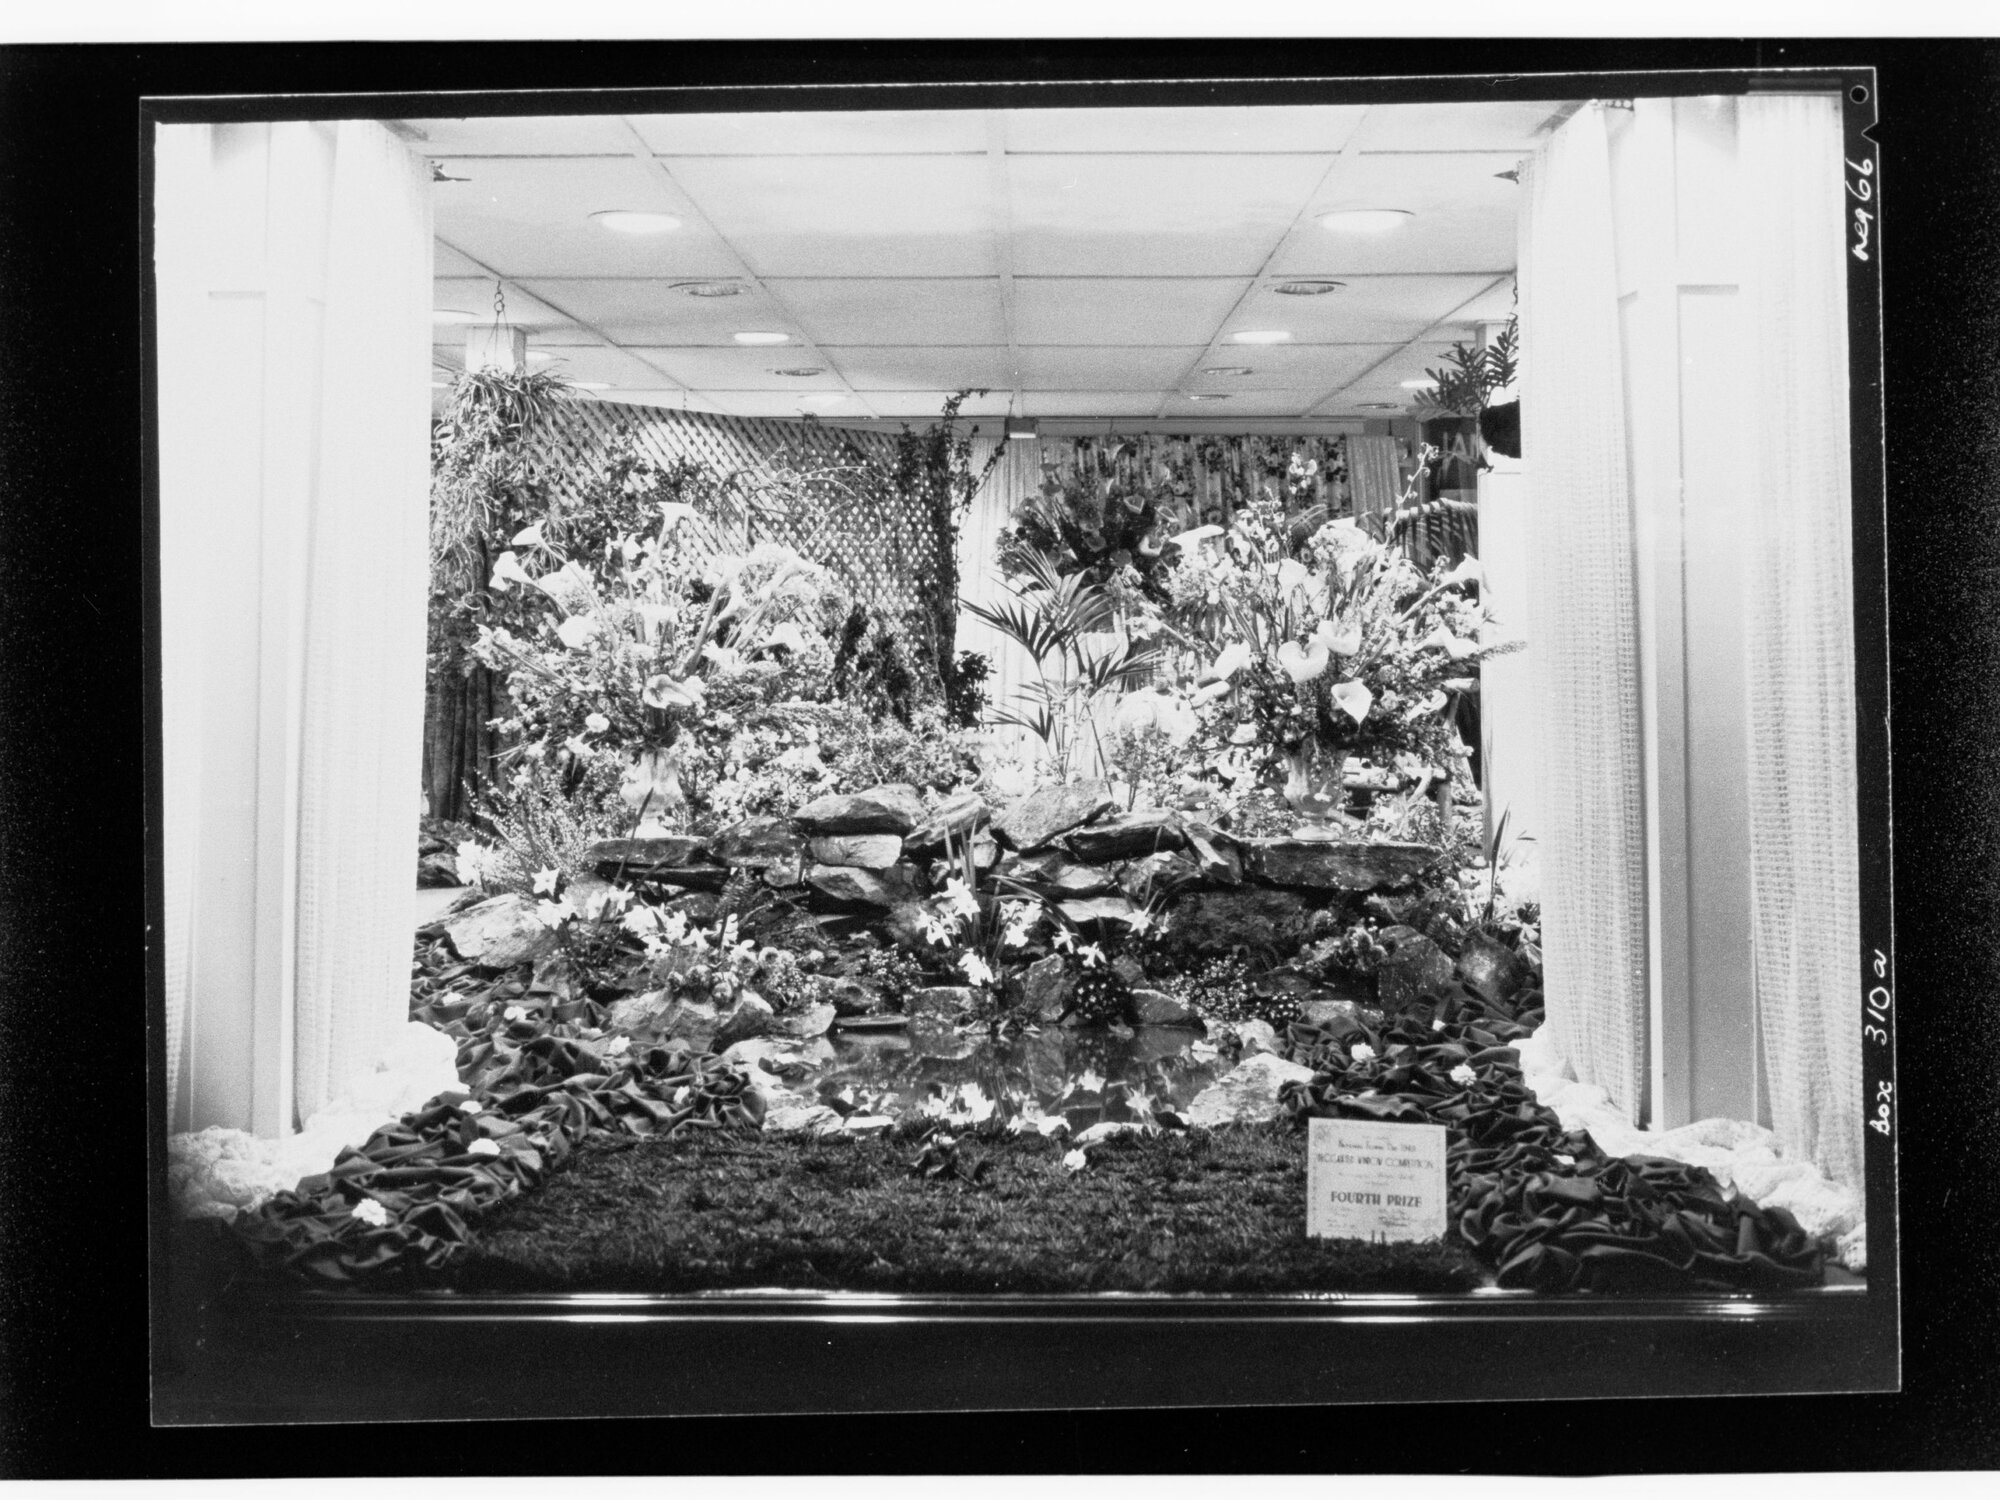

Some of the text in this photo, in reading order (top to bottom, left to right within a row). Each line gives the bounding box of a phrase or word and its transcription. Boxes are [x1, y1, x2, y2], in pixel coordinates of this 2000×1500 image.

[1845, 157, 1874, 261] neg 66
[1869, 1081, 1892, 1136] box
[1331, 1190, 1423, 1208] FOURTH PRIZE
